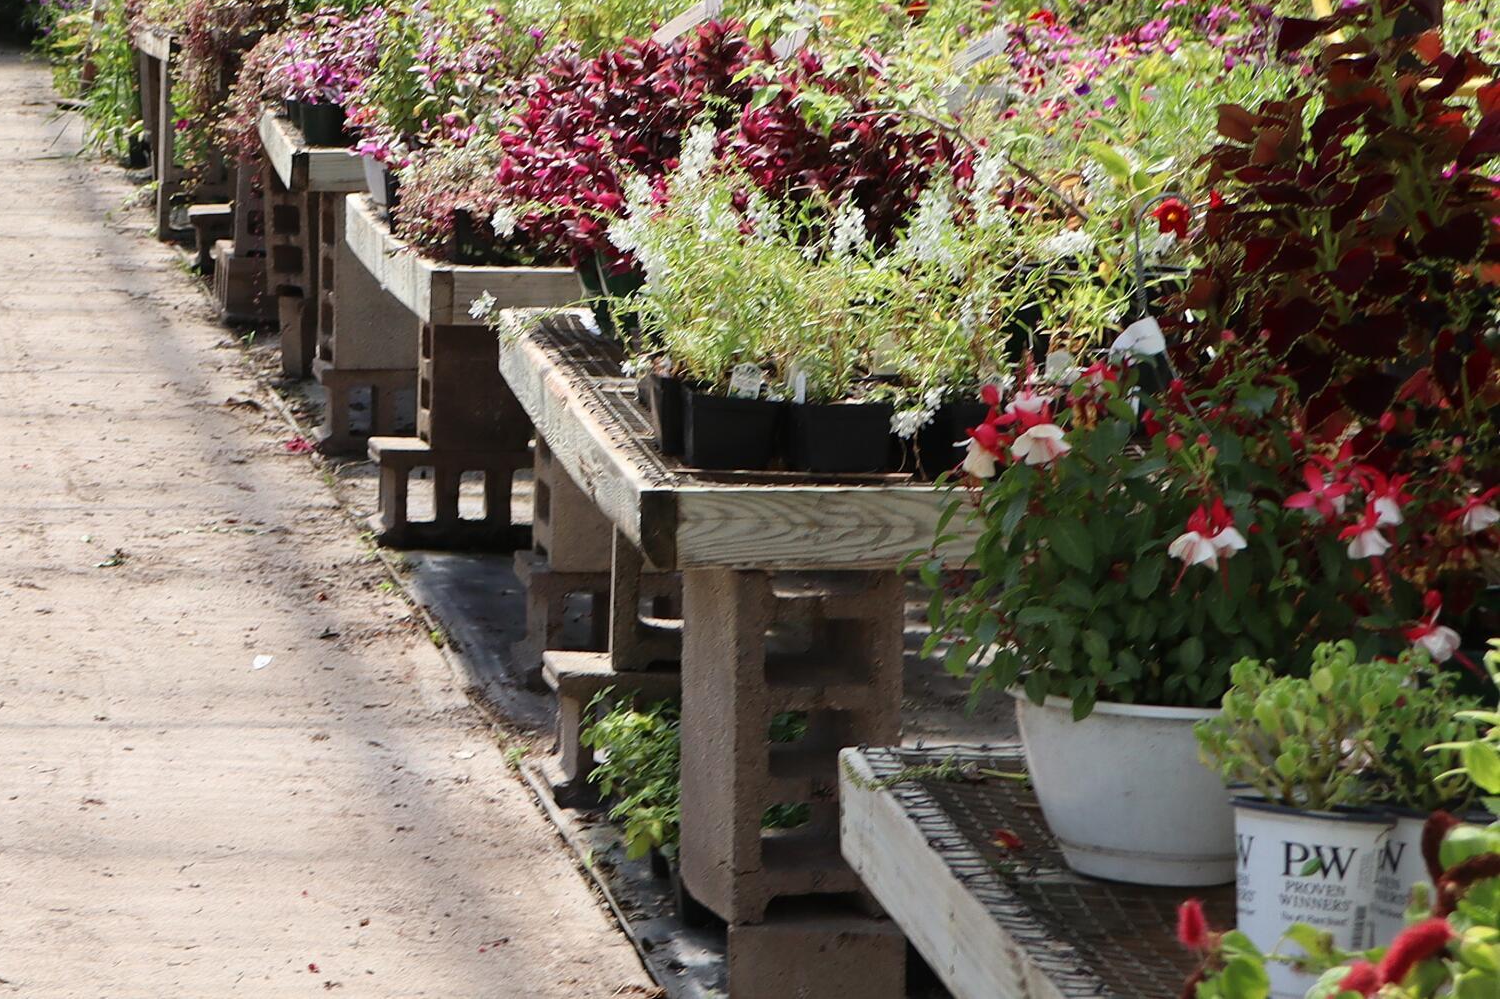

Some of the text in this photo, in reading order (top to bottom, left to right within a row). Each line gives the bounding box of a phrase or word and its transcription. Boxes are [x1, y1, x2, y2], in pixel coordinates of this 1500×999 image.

[1282, 840, 1358, 880] PW
[1285, 880, 1347, 897] PROVEN
[1279, 893, 1353, 912] WINNERS
